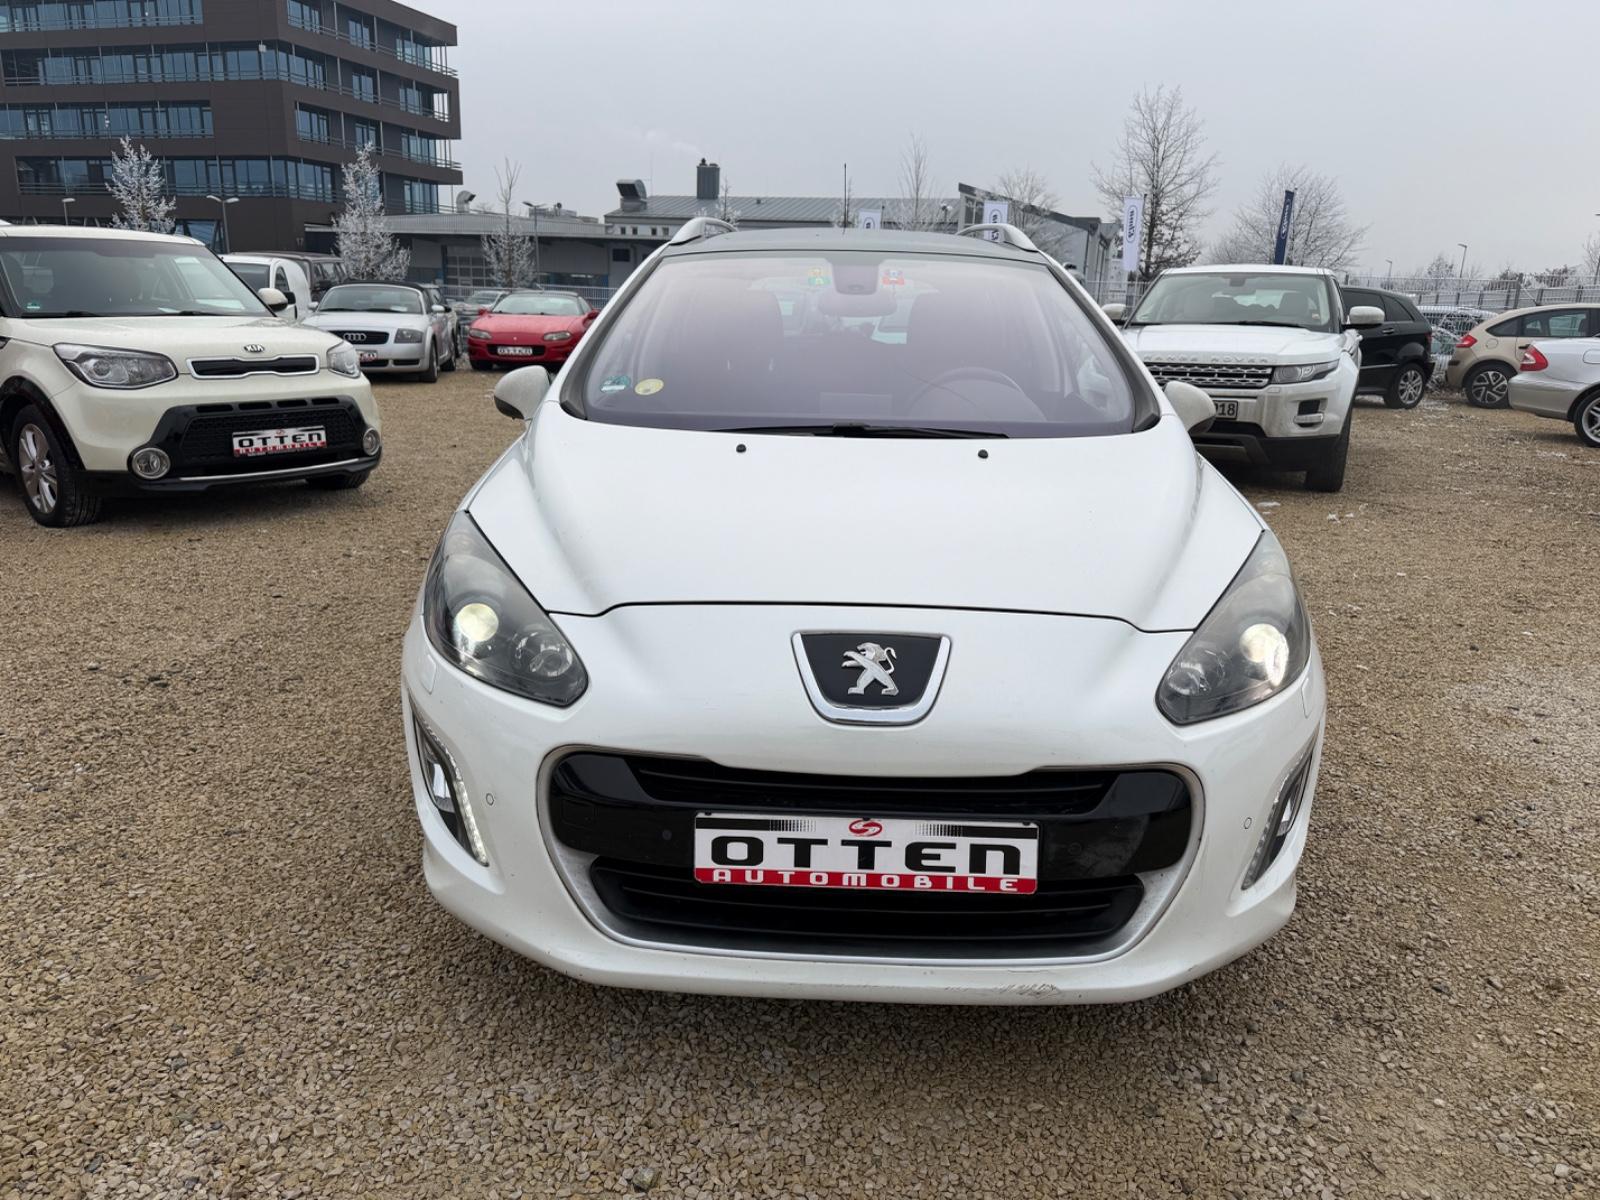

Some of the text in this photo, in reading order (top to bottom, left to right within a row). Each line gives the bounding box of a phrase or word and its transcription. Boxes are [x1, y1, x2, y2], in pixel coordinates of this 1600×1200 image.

[244, 344, 265, 352] KIA
[1143, 354, 1268, 364] RANGE ROVER
[238, 432, 322, 448] OTTEN
[710, 835, 1021, 876] OTTEN
[712, 868, 1019, 892] AUTOMOBILE
